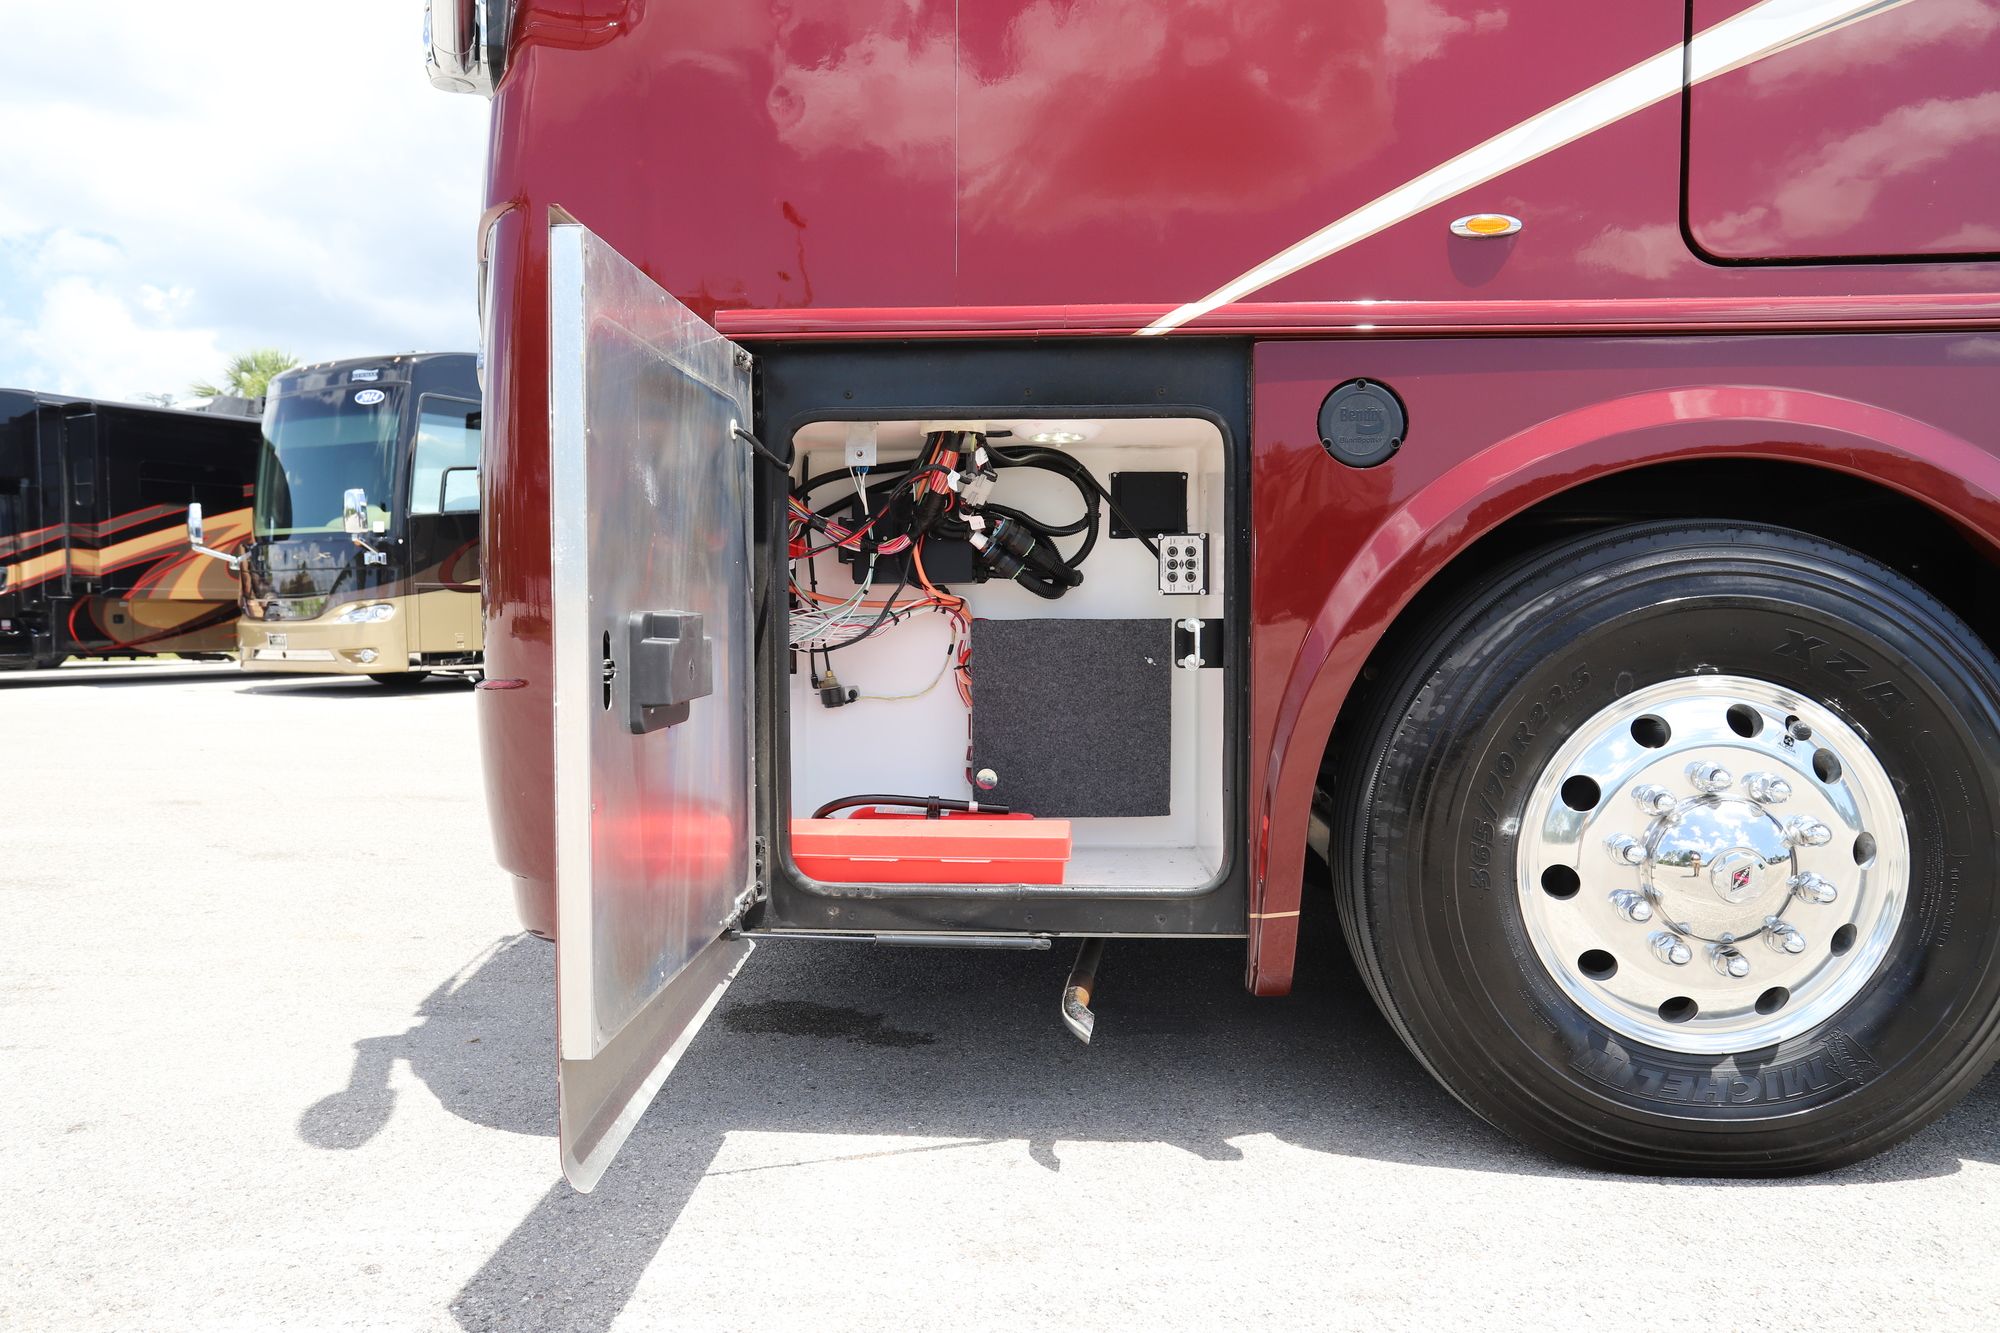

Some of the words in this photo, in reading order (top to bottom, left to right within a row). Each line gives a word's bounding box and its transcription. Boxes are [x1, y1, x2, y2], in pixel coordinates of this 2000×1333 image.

[1339, 406, 1385, 422] Bendix
[1771, 628, 1909, 719] XZA
[1569, 1049, 1831, 1105] MICHELIN
